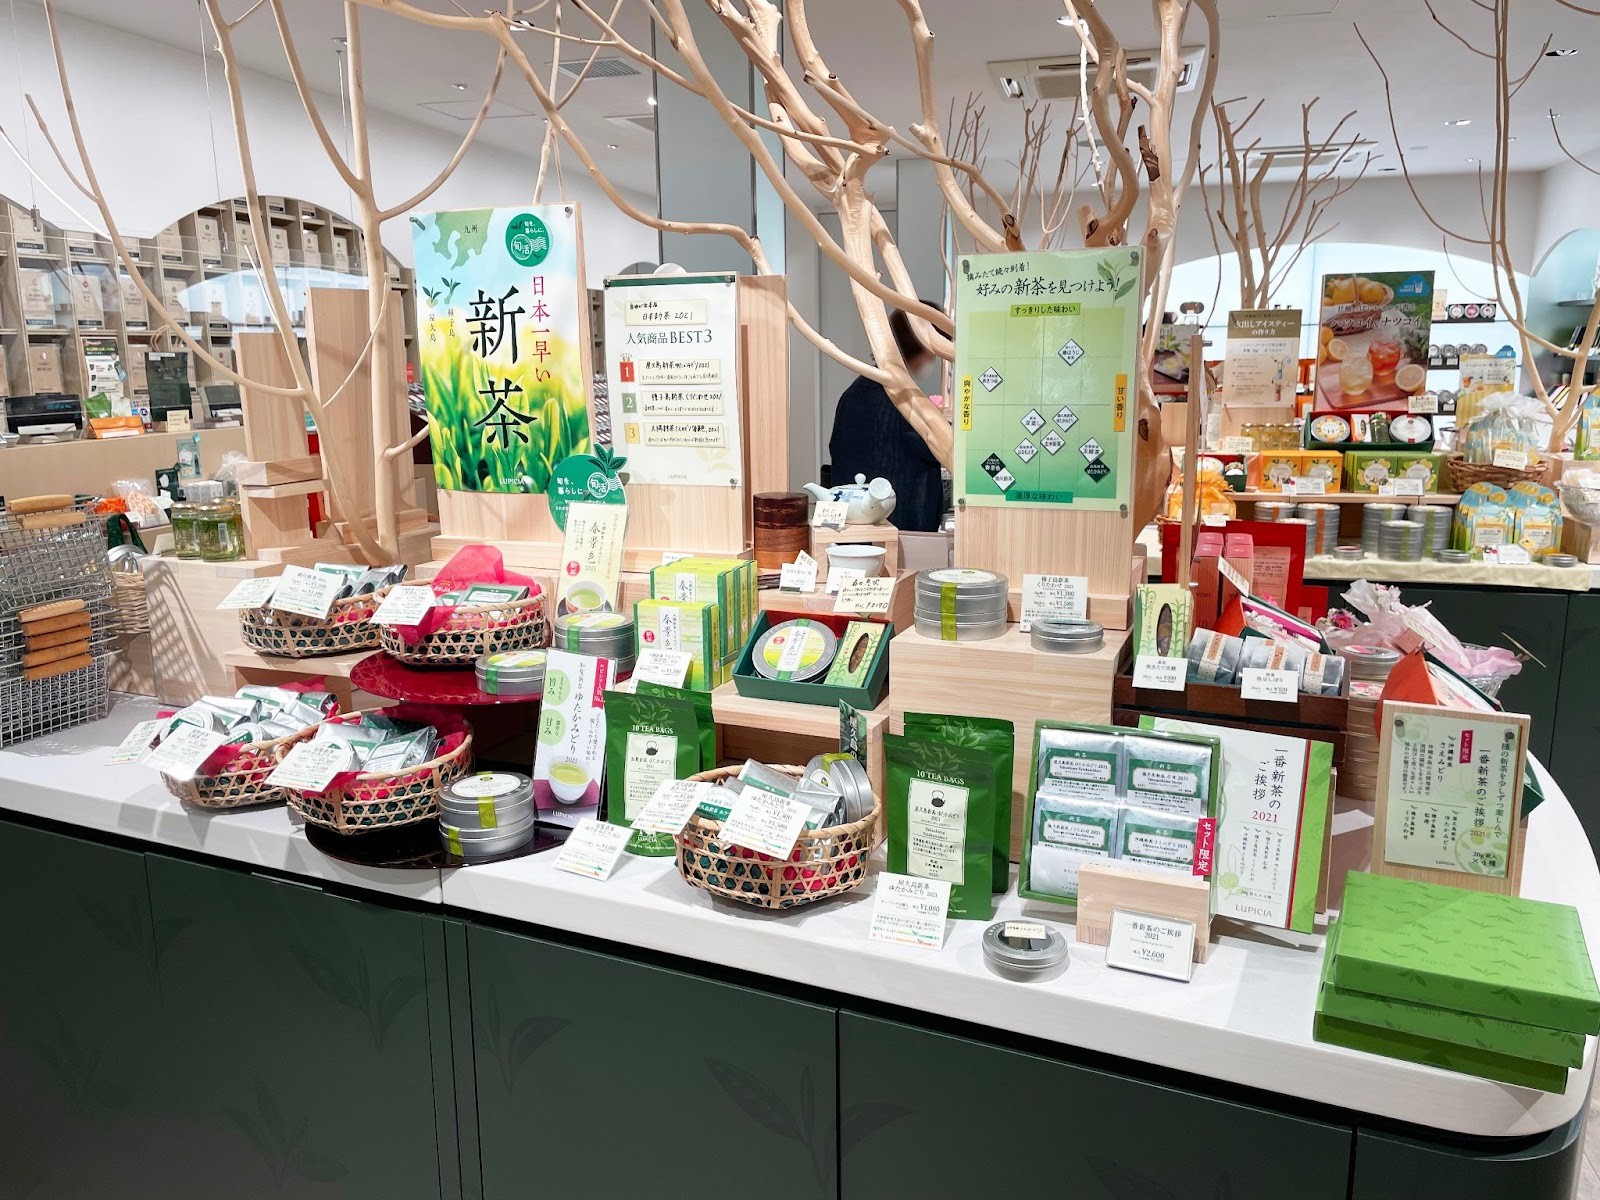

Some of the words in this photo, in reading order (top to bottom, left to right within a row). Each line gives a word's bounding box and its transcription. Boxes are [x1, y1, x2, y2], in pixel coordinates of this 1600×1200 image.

[464, 224, 478, 234] 九州
[513, 241, 530, 255] 旬活
[976, 277, 1121, 297] 好みの新茶を見つけよう!
[674, 312, 693, 320] 2021
[1014, 305, 1076, 314] すっきりした味わい
[530, 275, 551, 383] 日本一早い
[1234, 320, 1295, 329] 水出しアイスティー
[465, 285, 538, 449] 新茶
[963, 379, 971, 425] 爽やかな香り
[1116, 387, 1124, 418] 甘い香り
[500, 478, 525, 486] LUPICIA
[556, 477, 575, 486] 旬を、
[590, 479, 608, 494] 旬活
[1015, 491, 1063, 501] 濃厚な味わい
[548, 677, 556, 695] 旨み
[544, 717, 552, 735] 甘み
[570, 692, 583, 755] ゆたかみどり
[632, 724, 640, 732] 10
[641, 725, 654, 733] TEA
[1437, 742, 1446, 783] さえみどり
[917, 769, 925, 778] 10
[927, 771, 942, 781] TEA
[944, 775, 965, 785] BAGS
[1252, 760, 1270, 801] ご挨拶
[1269, 748, 1288, 810] 一番新茶の
[1473, 748, 1491, 828] 一番新茶のご挨拶
[1494, 738, 1511, 839] 種の新茶を少しずつ楽しんで
[1252, 811, 1278, 823] 2021
[1470, 830, 1486, 838] 2021
[1197, 822, 1212, 872] セット限定
[888, 885, 924, 895] ゆたかみどり
[898, 879, 930, 890] 屋久島新茶
[1235, 904, 1273, 918] LUPICIA
[1123, 922, 1182, 938] 一番新茶のご挨拶
[1144, 932, 1159, 940] 2021
[1142, 948, 1165, 959] ¥2,600
